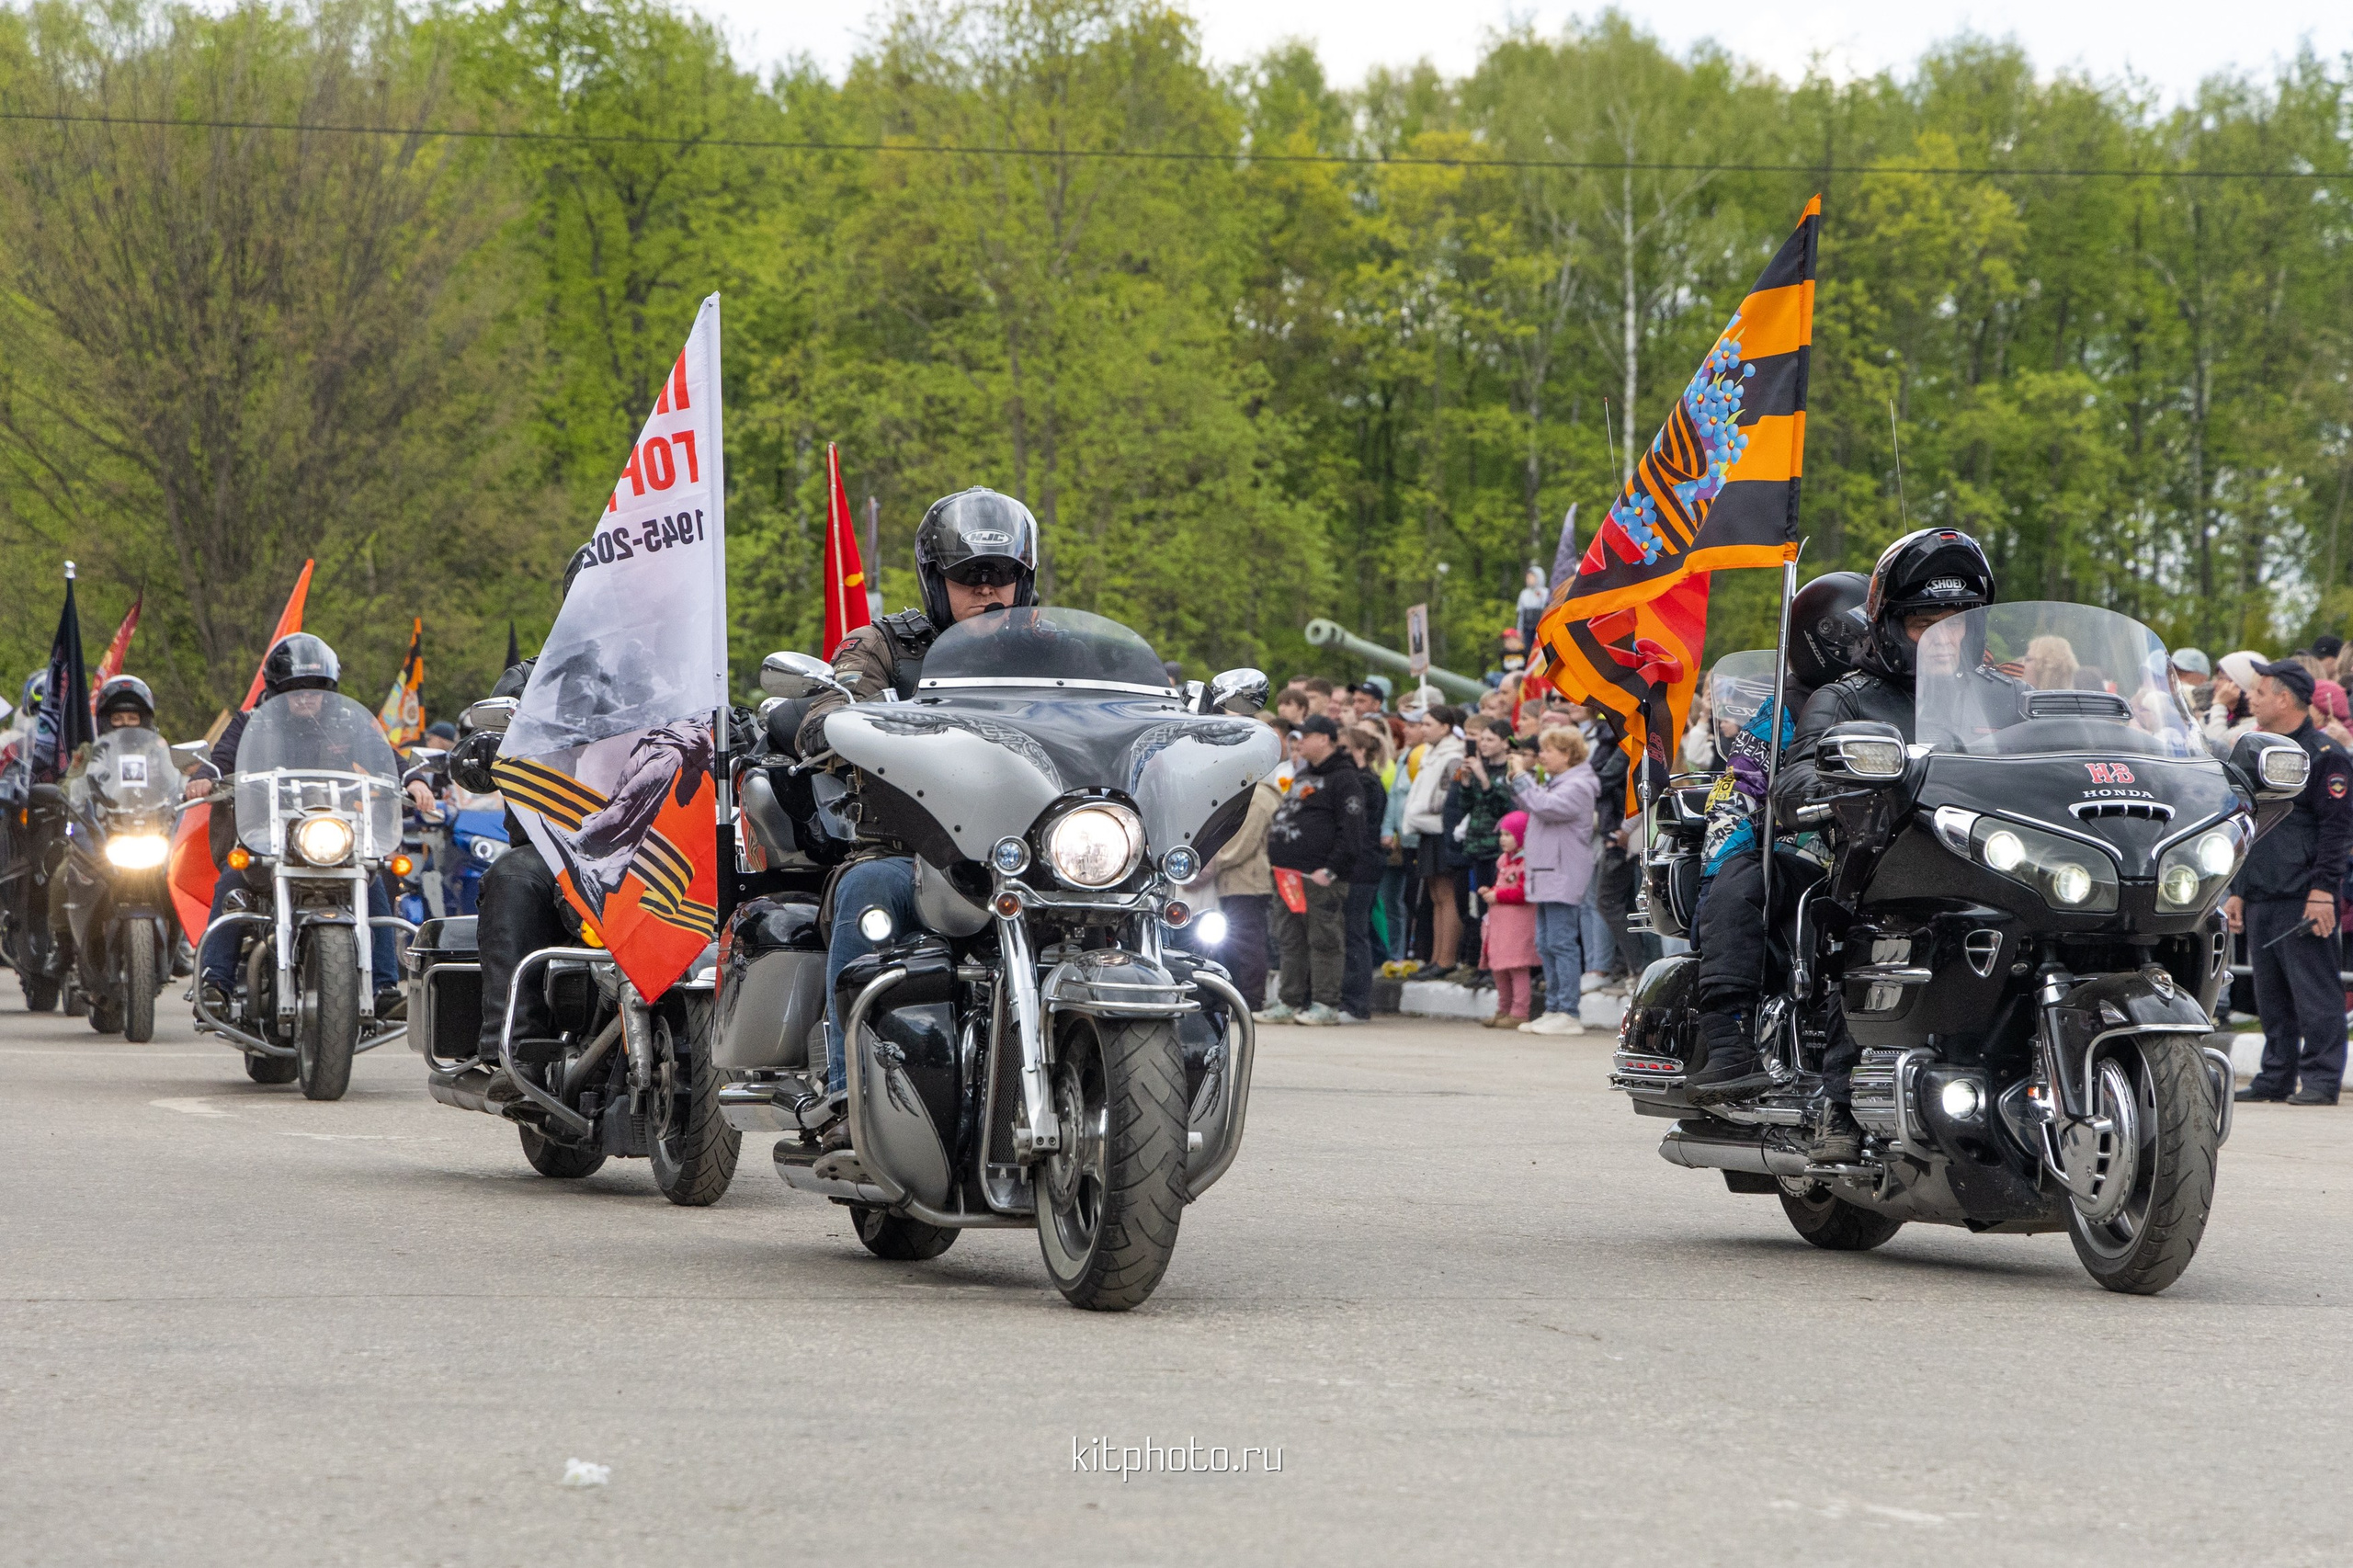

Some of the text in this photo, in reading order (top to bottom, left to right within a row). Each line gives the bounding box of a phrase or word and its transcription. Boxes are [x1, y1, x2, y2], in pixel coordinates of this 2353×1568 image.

[969, 533, 1006, 542] HJC
[1930, 578, 1962, 590] SHOEI
[2082, 789, 2155, 800] HONDA
